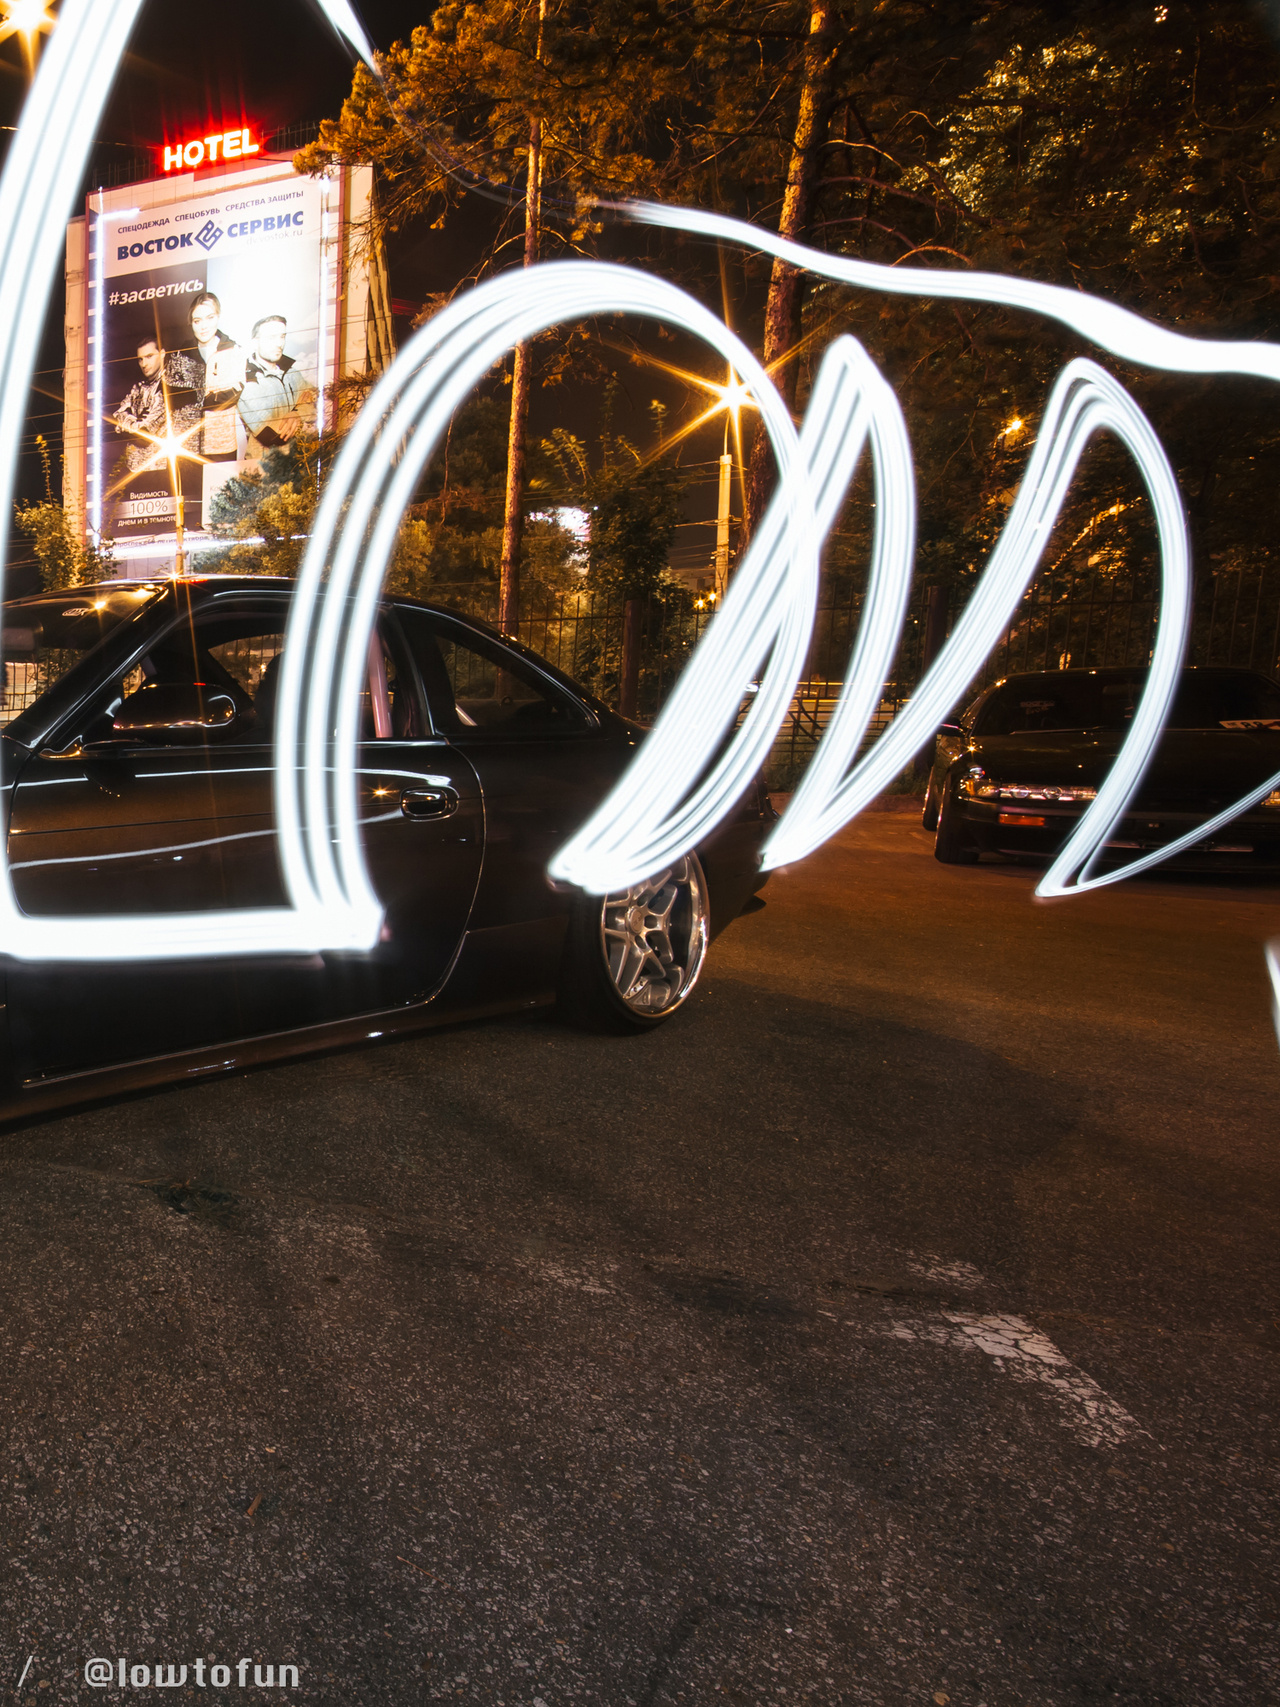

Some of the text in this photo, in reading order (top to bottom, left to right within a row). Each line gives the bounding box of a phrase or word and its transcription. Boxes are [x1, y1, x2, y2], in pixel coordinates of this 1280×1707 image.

[163, 128, 260, 171] HOTEL
[117, 190, 304, 235] СПЕЦОДЕЖДА СПЕЦОБУВЬ СРЕДСТВА ЗАЩИТЫ
[117, 210, 304, 260] ВОСТОК СЕРВИС
[108, 277, 204, 306] #засветись
[130, 490, 168, 500] Видимость
[130, 500, 168, 515] 100%
